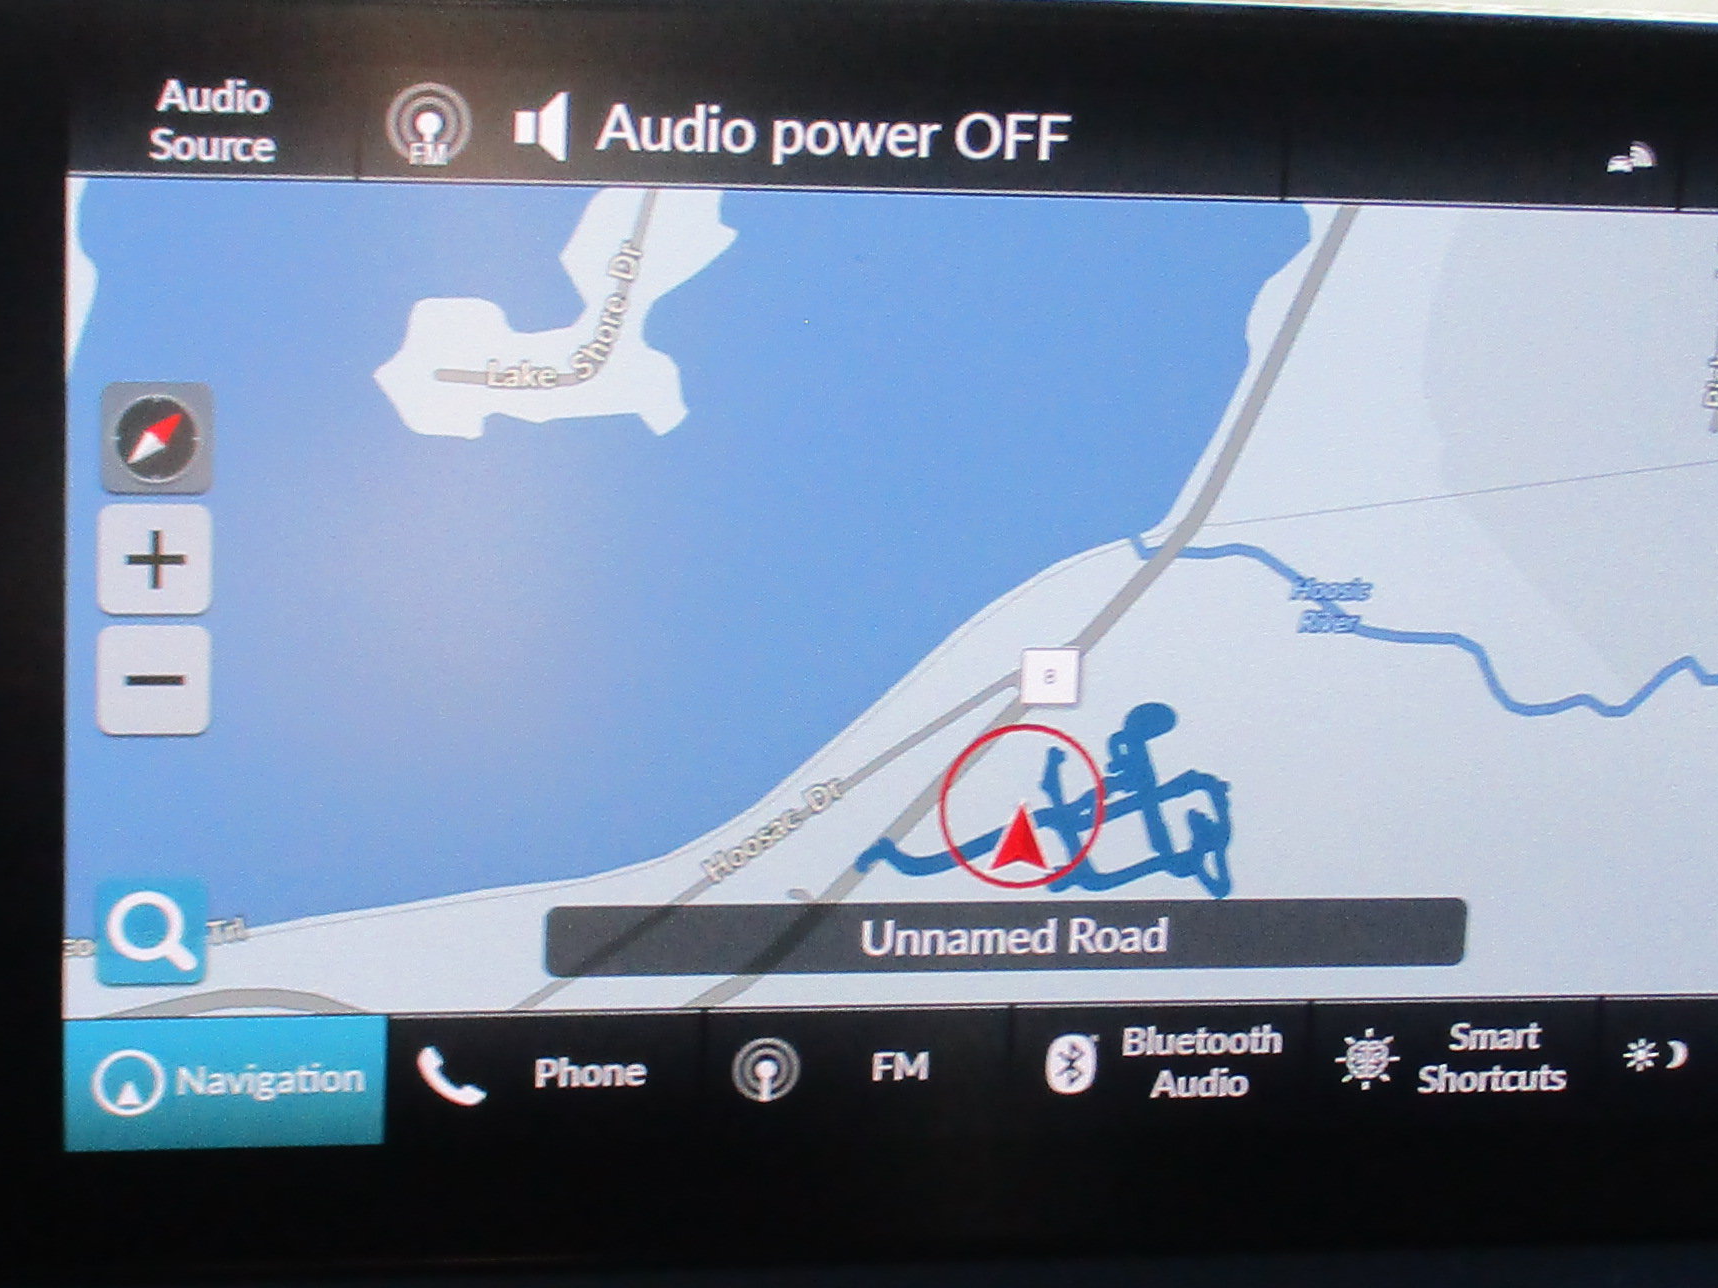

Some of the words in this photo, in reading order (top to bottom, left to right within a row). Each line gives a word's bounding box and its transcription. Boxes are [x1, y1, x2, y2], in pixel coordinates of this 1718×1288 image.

[155, 78, 271, 114] Audio
[148, 127, 276, 163] Source
[594, 103, 757, 155] Audio
[771, 120, 943, 165] power
[954, 112, 1074, 162] OFF
[409, 142, 449, 165] FM
[486, 359, 558, 389] Lake
[571, 292, 628, 381] Shore
[606, 240, 644, 282] Dr
[801, 778, 844, 814] Dr
[861, 918, 1058, 957] Unnamed
[1068, 917, 1170, 955] Road
[1122, 1023, 1283, 1057] Bluetooth
[1449, 1022, 1543, 1052] Smart
[176, 1061, 367, 1103] Navigation
[533, 1055, 648, 1089] Phone
[871, 1050, 930, 1082] FM
[1149, 1068, 1250, 1099] Audio
[1417, 1062, 1568, 1094] Shortcuts
